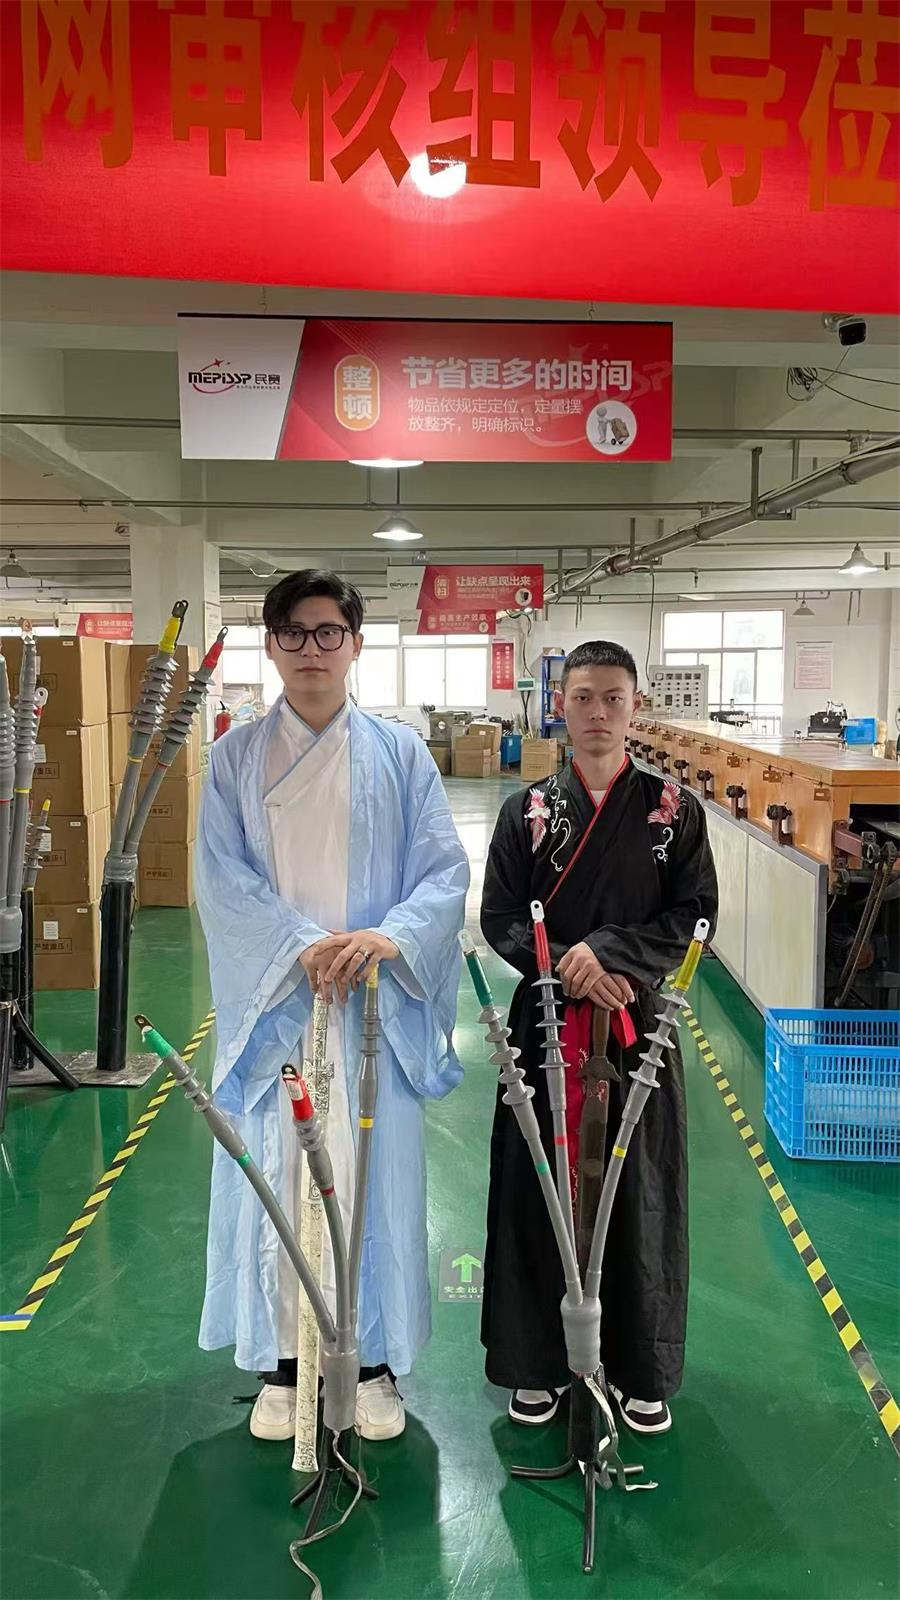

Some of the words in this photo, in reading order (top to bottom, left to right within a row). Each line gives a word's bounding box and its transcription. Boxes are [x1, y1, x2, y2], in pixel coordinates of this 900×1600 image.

[402, 357, 632, 391] 节省更多的时间
[343, 366, 373, 420] 整顿
[408, 398, 584, 415] 物品依规定定位，定量摆
[408, 416, 544, 433] 放整齐，明确标识。
